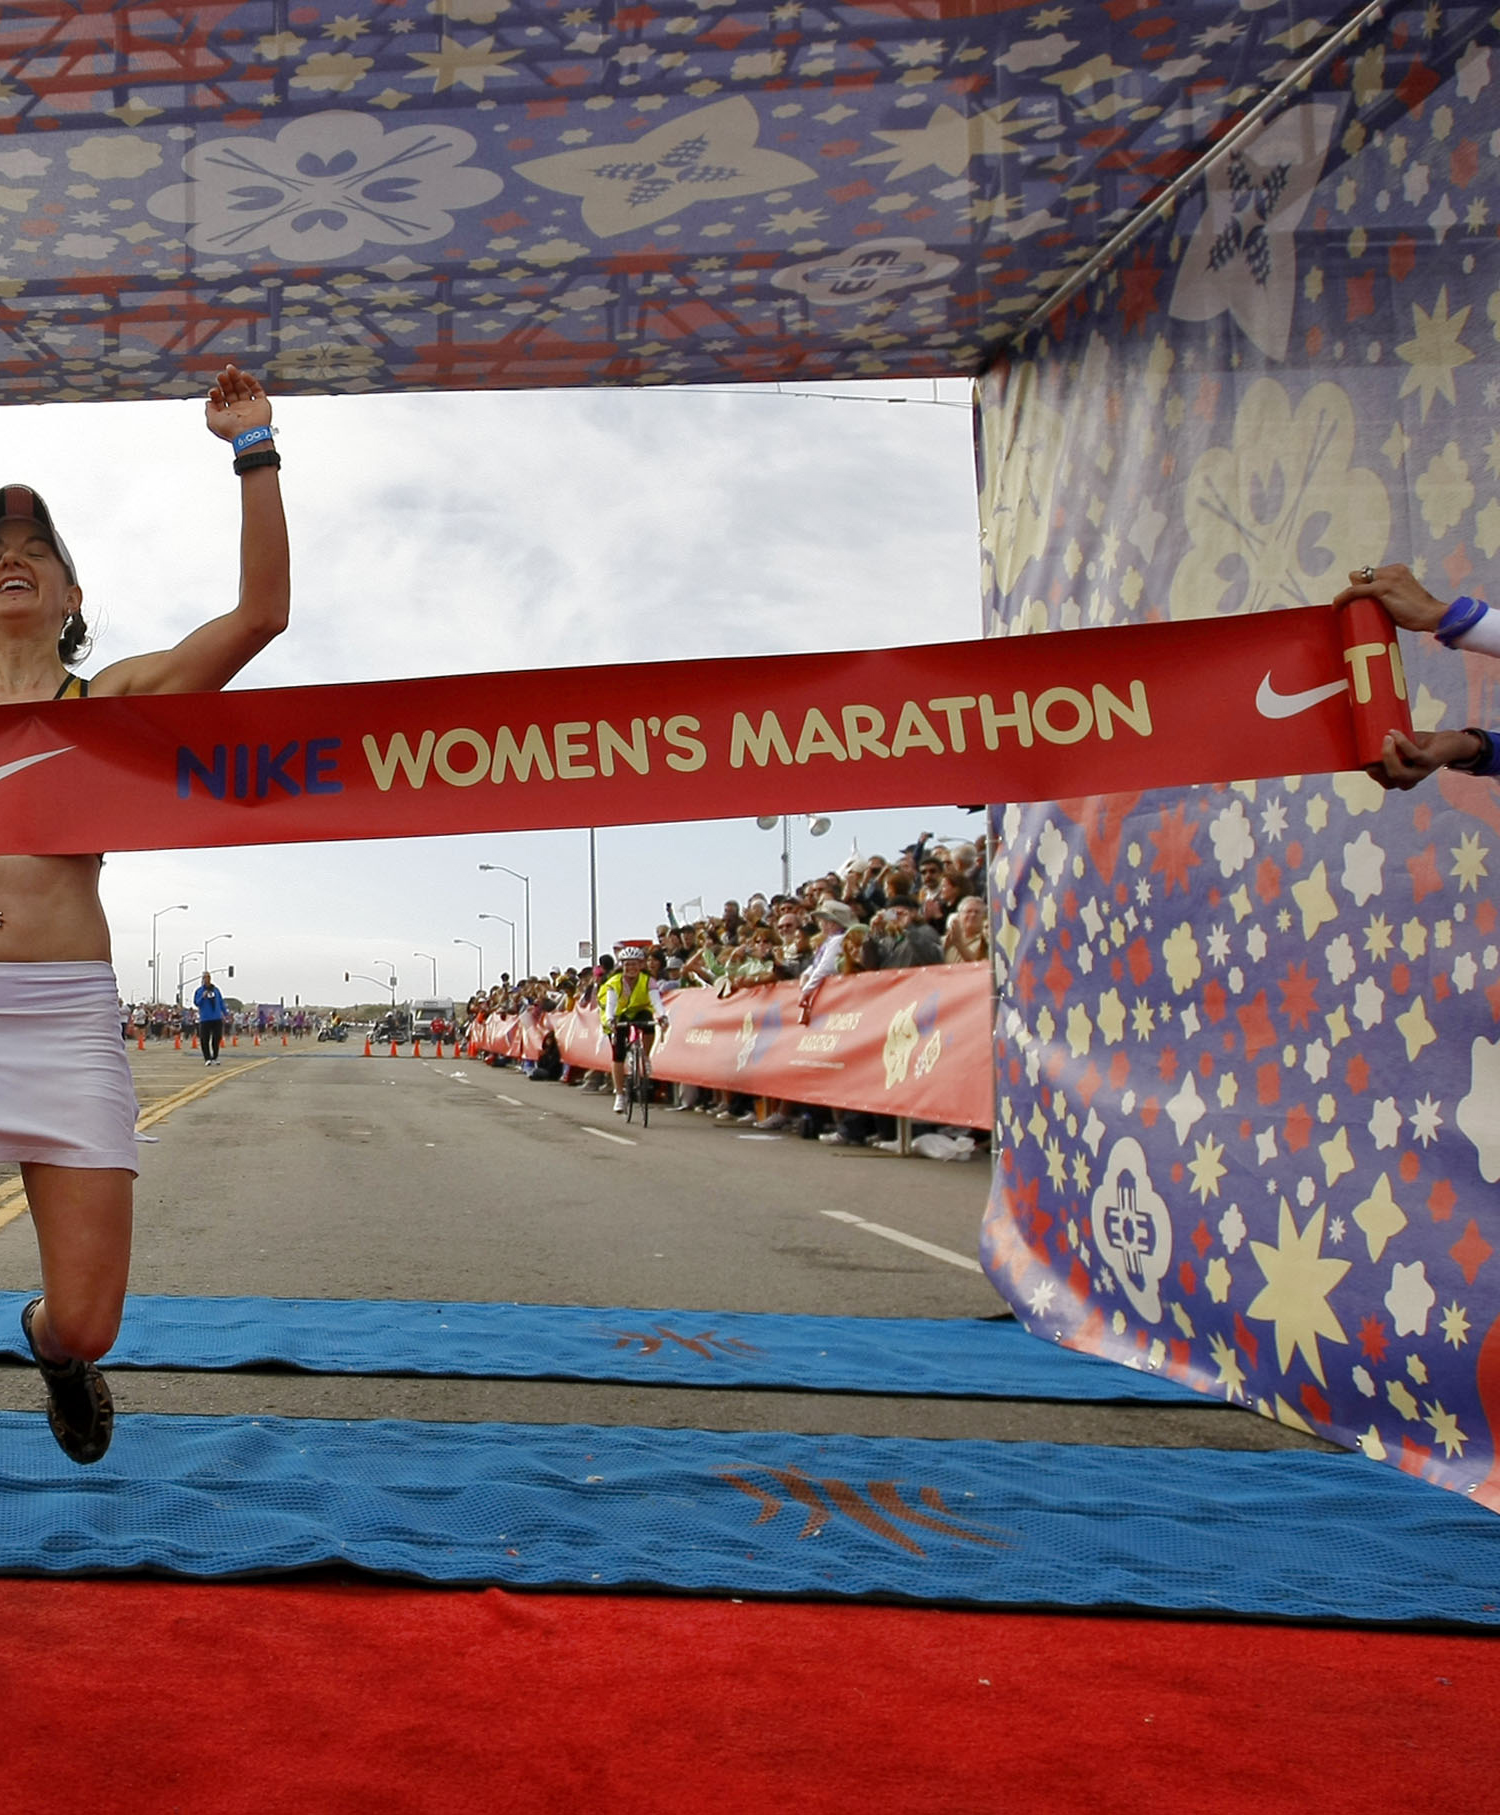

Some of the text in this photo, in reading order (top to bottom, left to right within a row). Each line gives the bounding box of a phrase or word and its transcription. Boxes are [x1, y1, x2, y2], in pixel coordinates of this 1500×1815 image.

[176, 679, 1153, 800] NIKE WOMEN'S MARATHON
